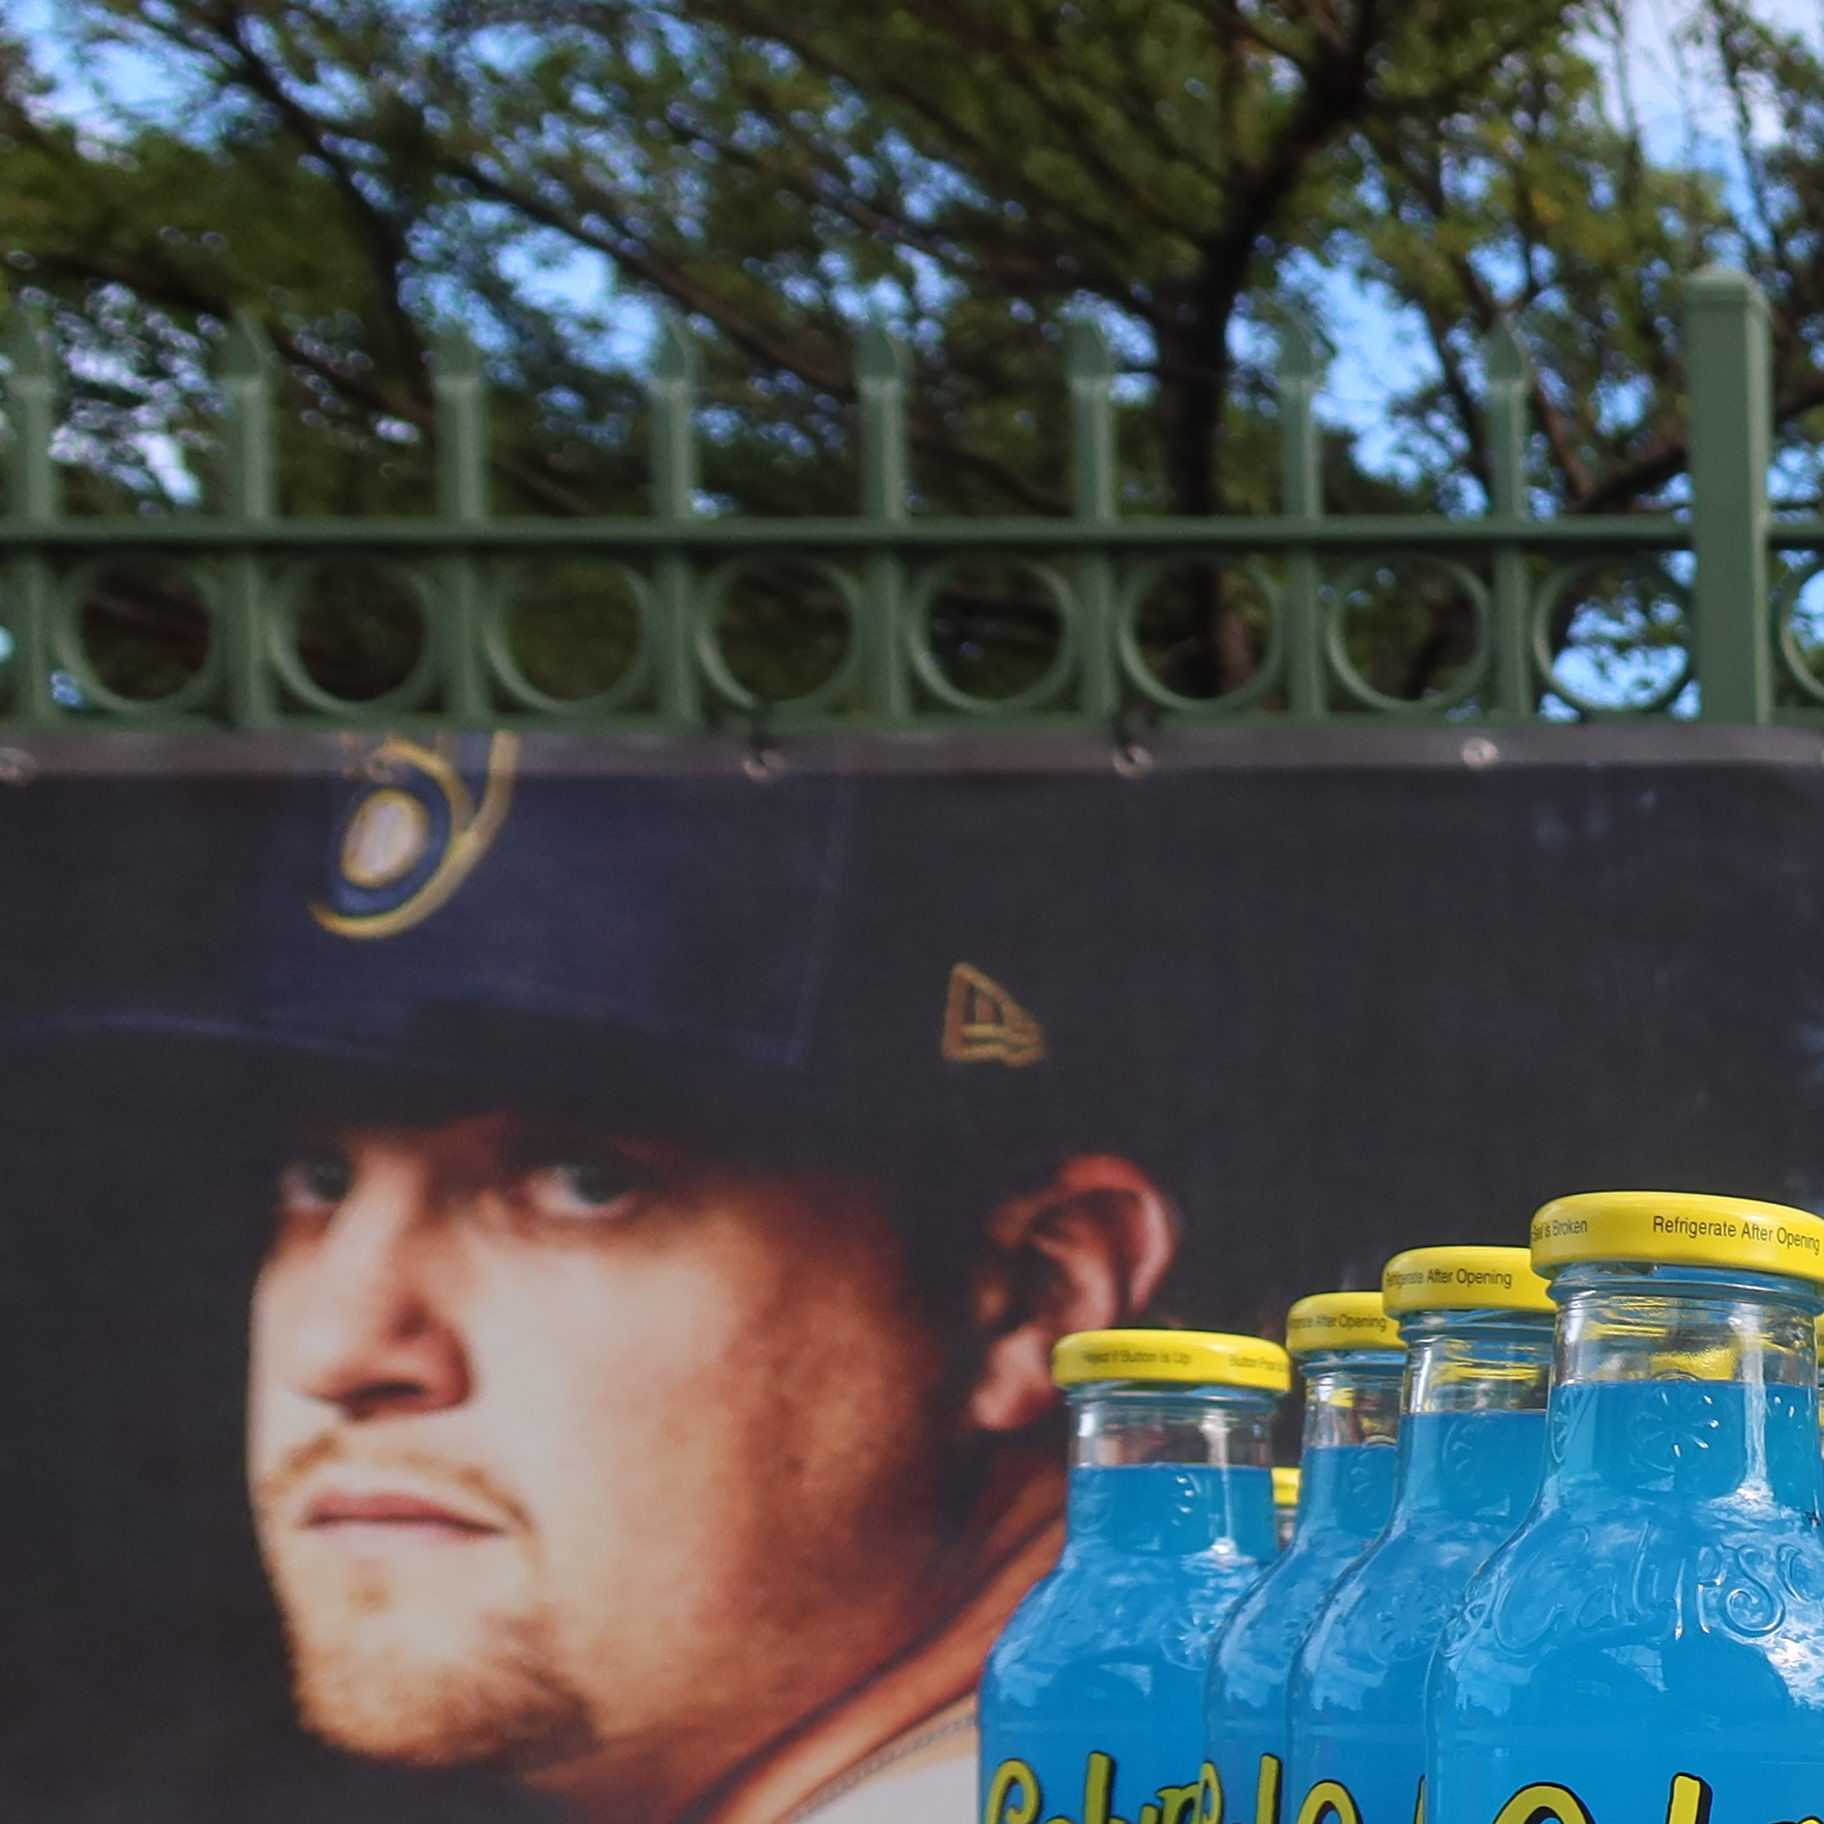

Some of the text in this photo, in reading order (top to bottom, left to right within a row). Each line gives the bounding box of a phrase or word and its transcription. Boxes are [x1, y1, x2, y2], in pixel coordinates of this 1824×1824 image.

[1652, 1215, 1820, 1256] Refrigerate After Opening
[1427, 1269, 1454, 1285] After
[1456, 1268, 1512, 1289] Opening
[1340, 1313, 1386, 1332] Opening
